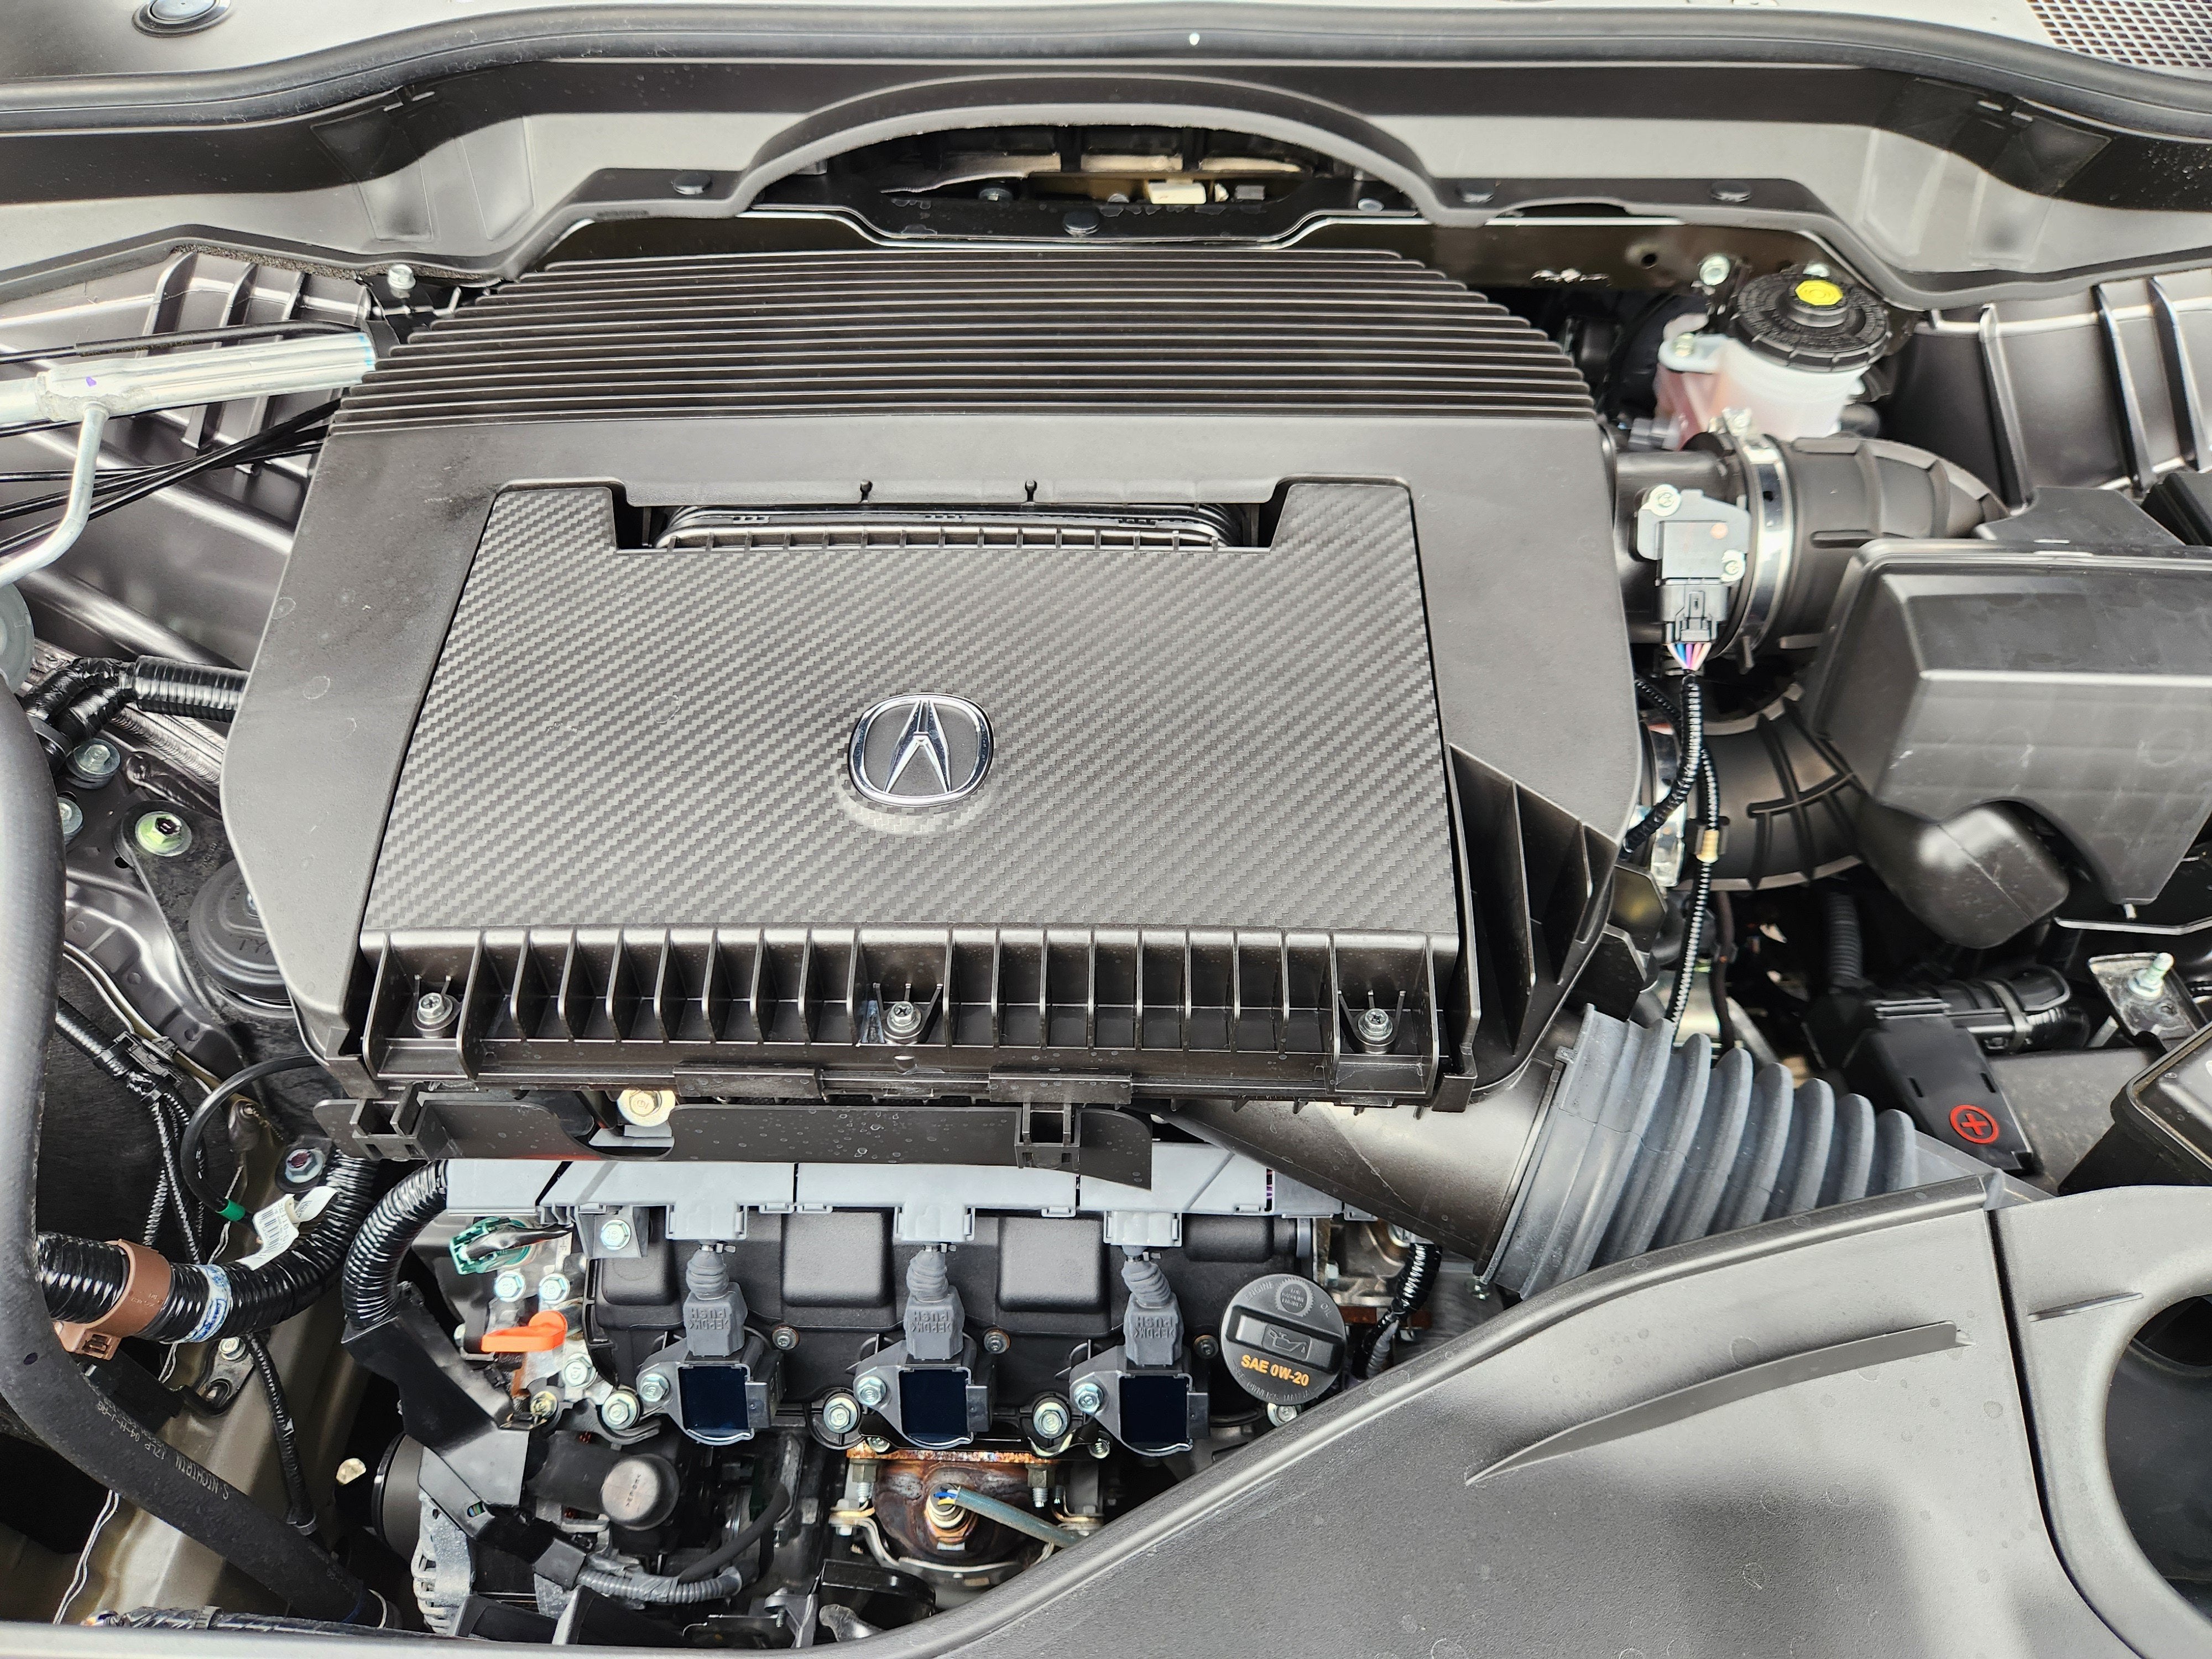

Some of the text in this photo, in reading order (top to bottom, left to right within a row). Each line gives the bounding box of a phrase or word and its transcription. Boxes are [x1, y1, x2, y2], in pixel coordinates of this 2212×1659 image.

[1244, 1280, 1333, 1318] ENGINE OIL
[692, 1308, 726, 1319] PUSH
[914, 1311, 948, 1322] PUSH
[1138, 1316, 1173, 1328] PUSH
[1240, 1354, 1310, 1386] SAE 0W-20
[1246, 1382, 1279, 1401] OWNER'S
[1283, 1389, 1315, 1402] MANUAL
